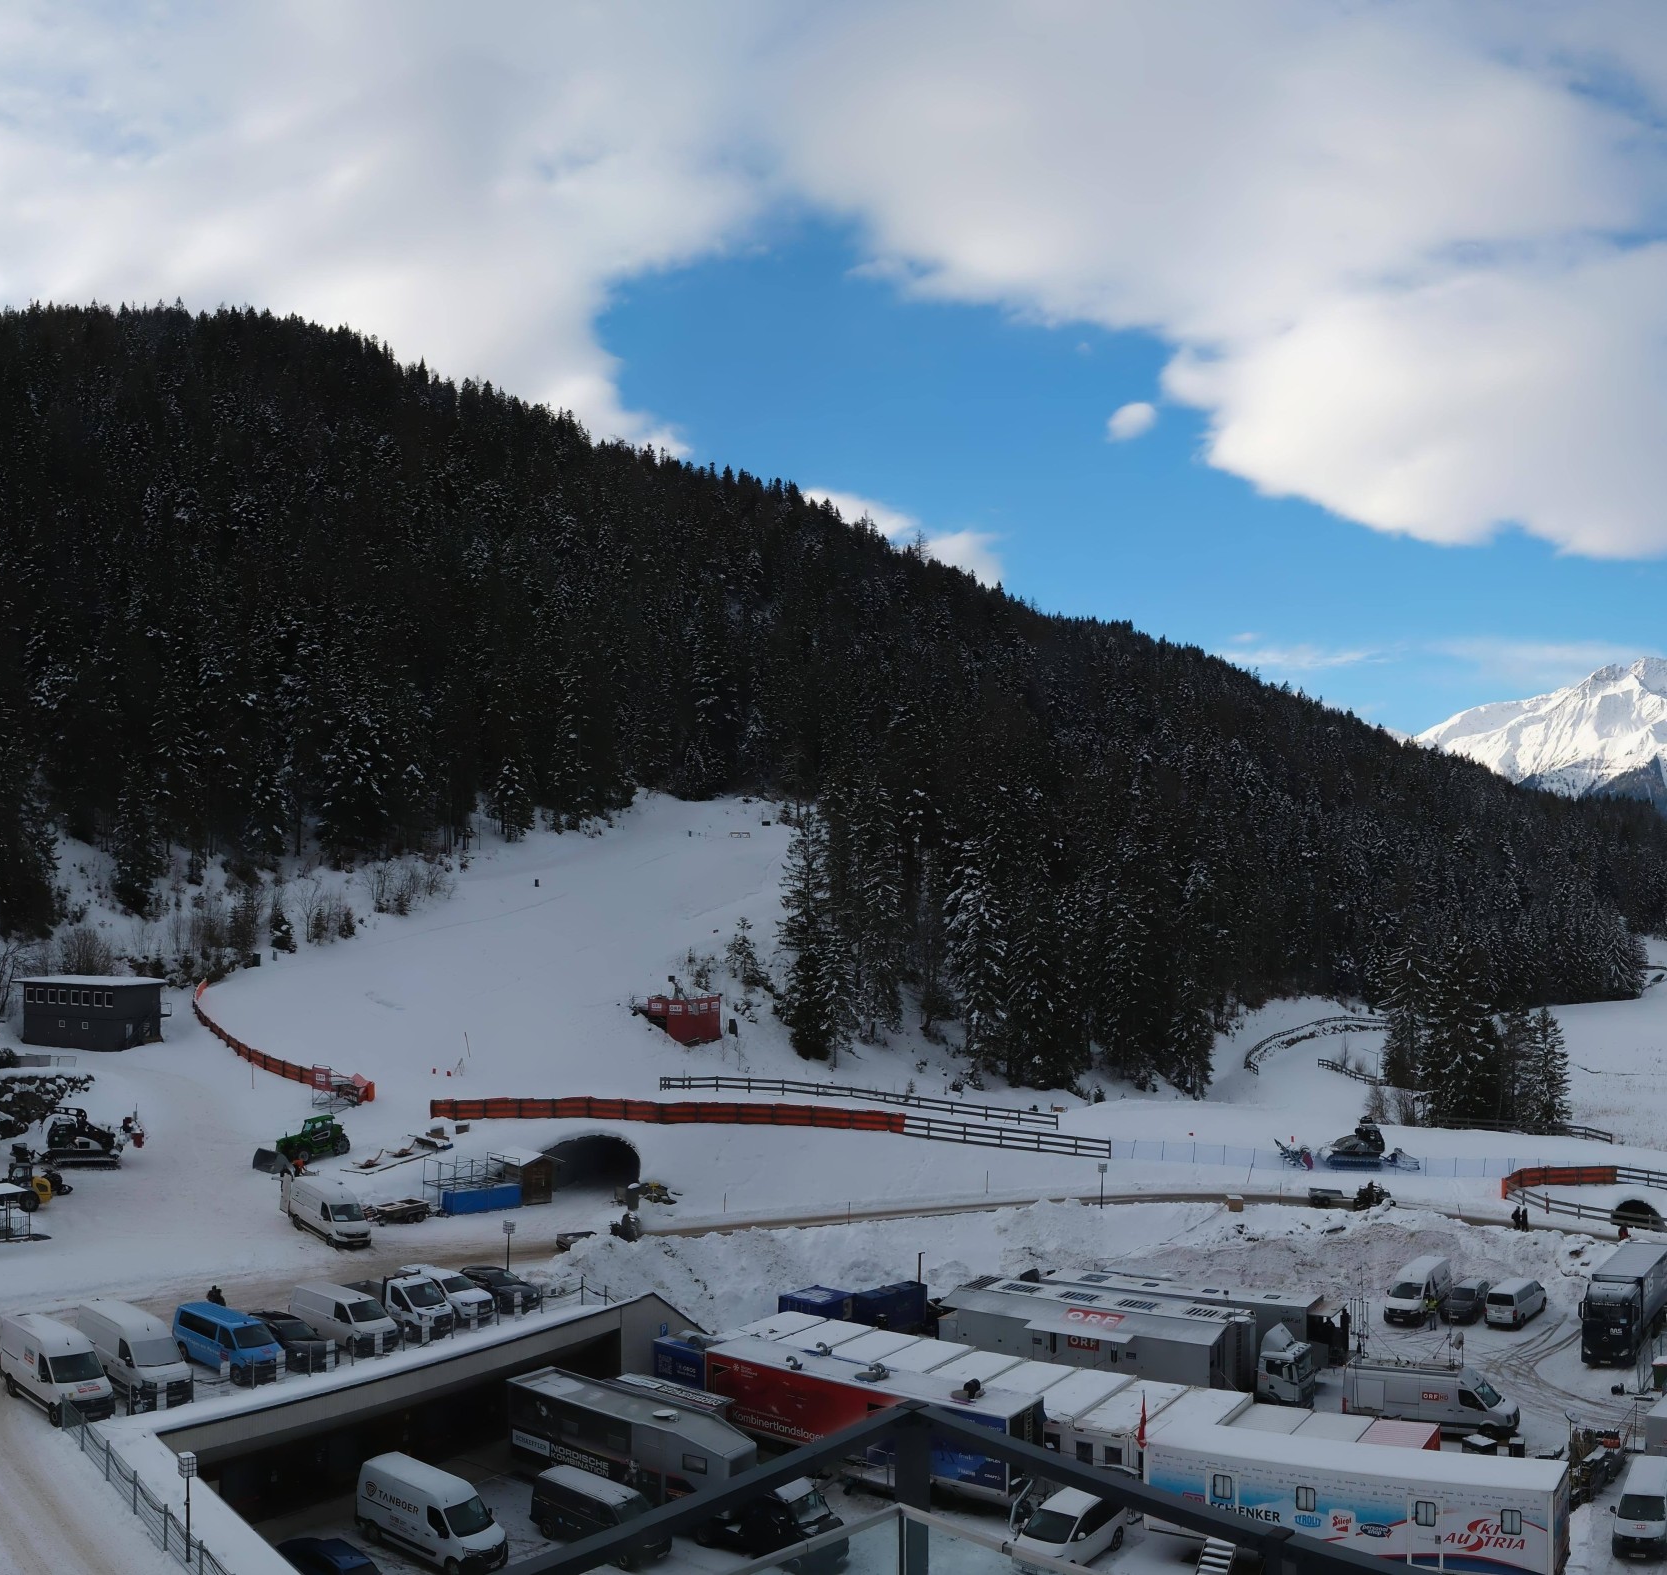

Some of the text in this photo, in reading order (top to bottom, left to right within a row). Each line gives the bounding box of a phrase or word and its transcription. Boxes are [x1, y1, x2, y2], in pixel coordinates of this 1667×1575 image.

[1068, 1311, 1119, 1326] ORF
[1070, 1336, 1097, 1348] ORF
[515, 1434, 547, 1450] SCHAEFFLER
[551, 1443, 609, 1470] NORDISCHE
[550, 1452, 609, 1477] KOMBINATION
[379, 1490, 419, 1515] TANBOER
[1294, 1515, 1322, 1527] TYROLIT
[1332, 1516, 1352, 1528] Stiegl
[1361, 1524, 1389, 1534] personal
